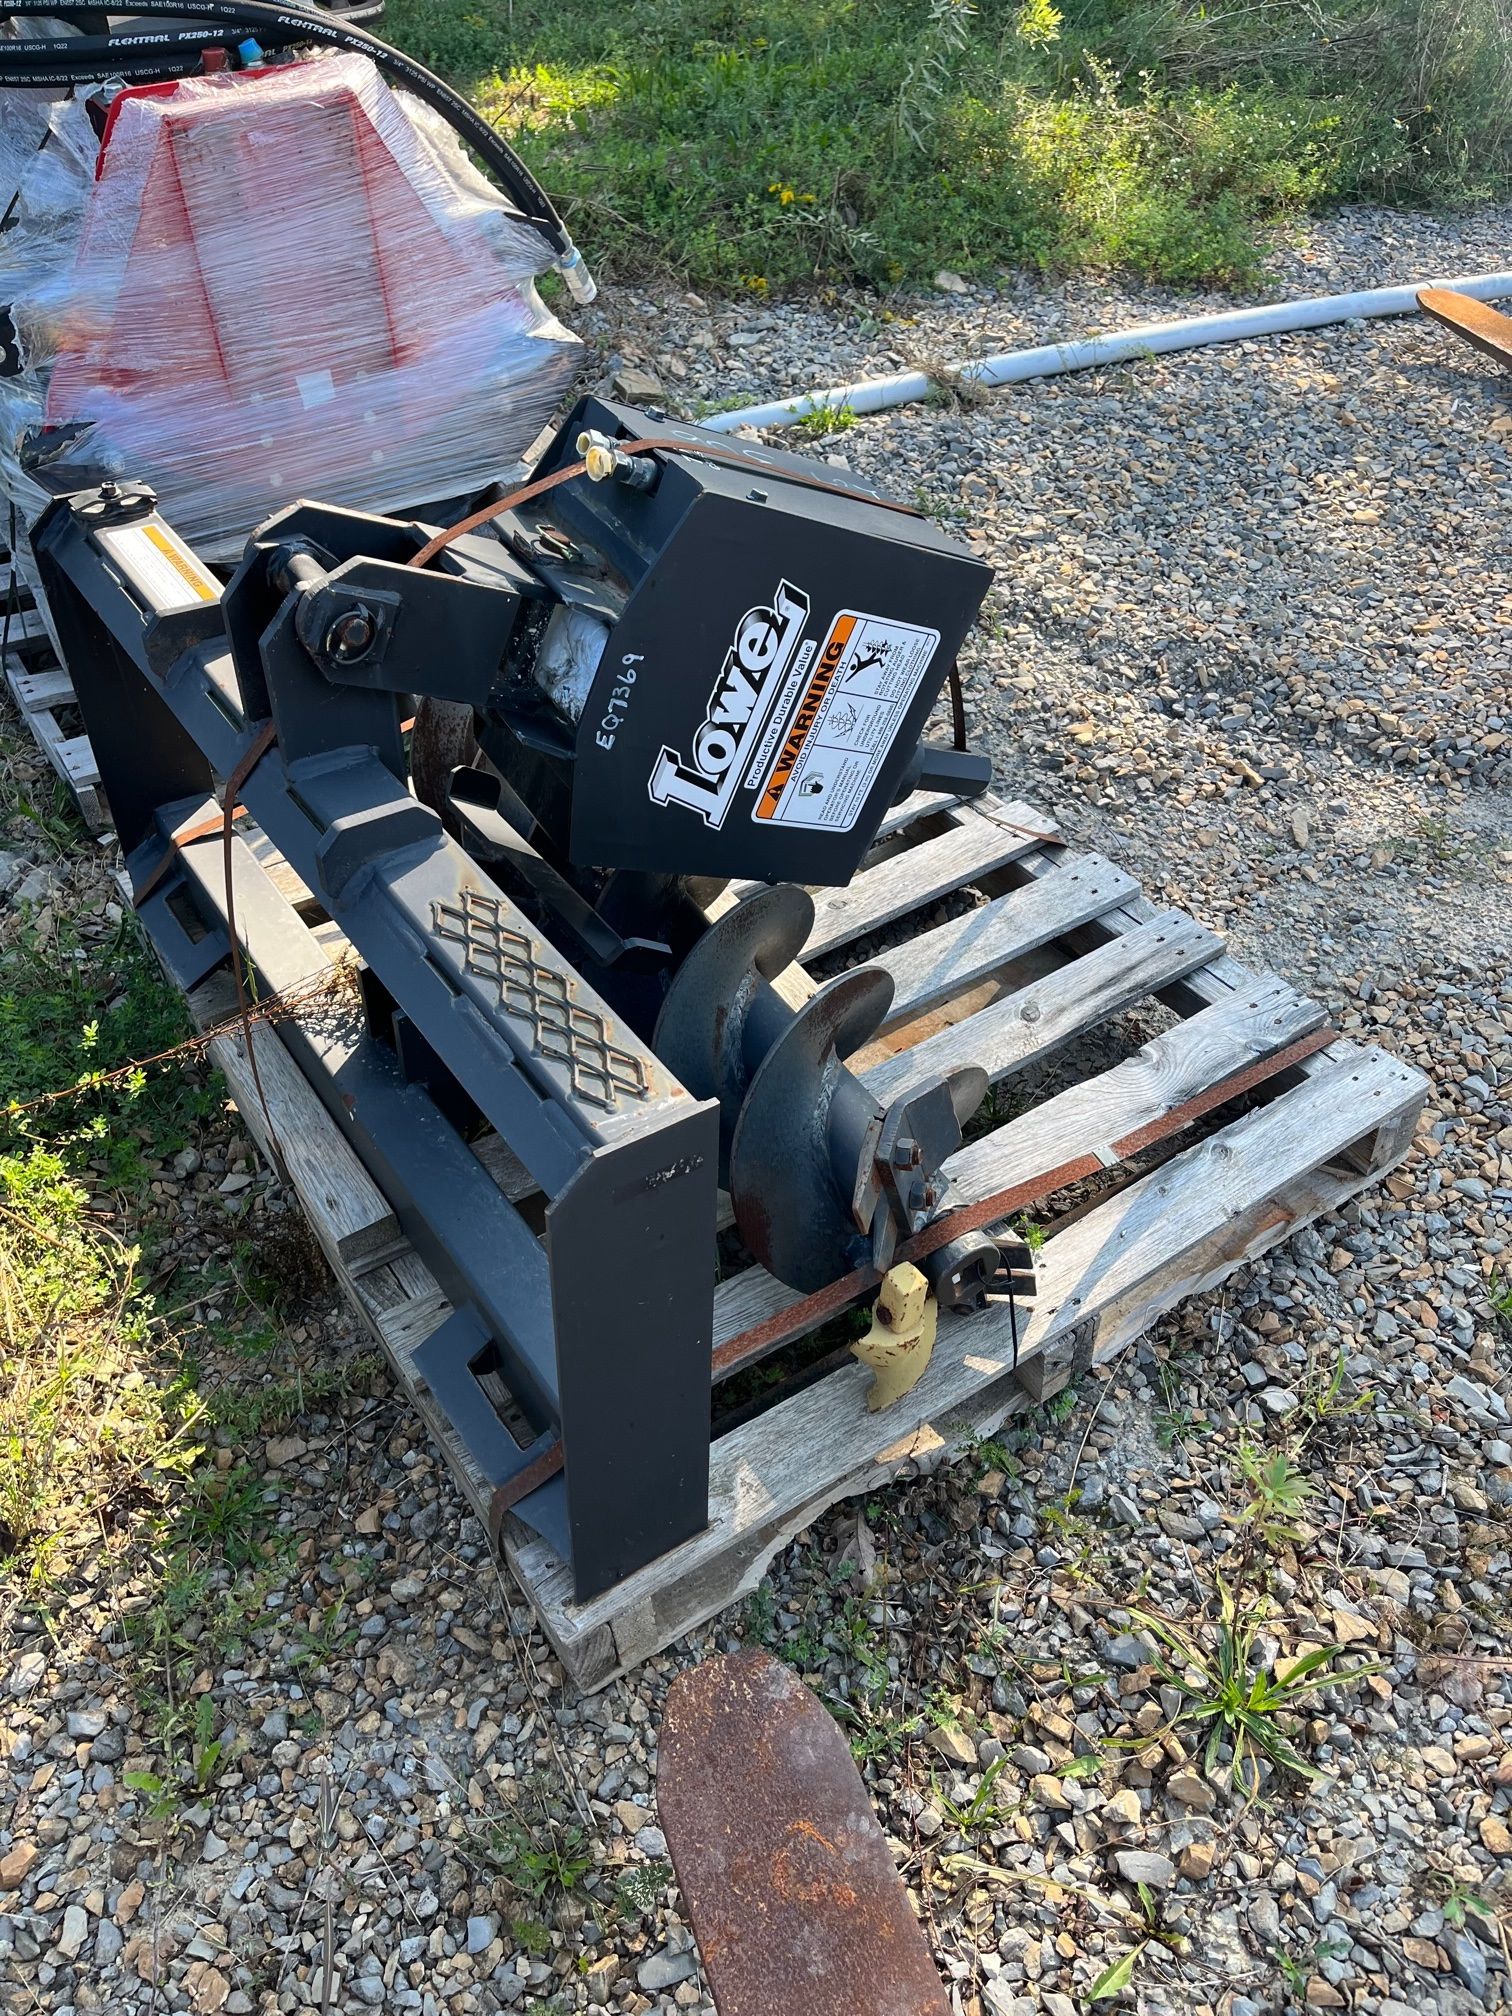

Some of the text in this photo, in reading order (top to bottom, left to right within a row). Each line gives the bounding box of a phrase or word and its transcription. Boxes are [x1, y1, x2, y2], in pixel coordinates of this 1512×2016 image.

[108, 35, 170, 46] FLEXTRAL
[178, 29, 224, 40] PX250-12
[278, 15, 338, 38] FLEXTRAL
[344, 36, 388, 59] PX250-12
[168, 553, 204, 588] WARNING
[874, 645, 899, 694] STAY AWAY FROM
[879, 667, 894, 695] ROTATING
[892, 646, 904, 666] AUGER
[884, 654, 905, 696] CUTTING HEAD
[890, 638, 919, 697] DO NOT WEAR LOOSE
[895, 646, 921, 698] FITTING CLOTHING
[596, 653, 644, 750] EQ7369
[776, 640, 844, 773] WARNING
[791, 661, 846, 781] AVOID INJURY OR DEATH
[872, 749, 882, 764] MORE
[880, 733, 889, 748] AWAY
[887, 710, 900, 732] UNLESS
[897, 677, 915, 709] OPERATING
[913, 649, 927, 676] MACHINE
[747, 726, 778, 786] Productive
[773, 679, 798, 724] Durable
[854, 727, 865, 745] CHECK
[860, 704, 881, 746] UNDERGROUND
[865, 710, 884, 747] UTILITY LINES
[830, 757, 848, 792] UNDERSTAND
[835, 769, 861, 821] SERVICING MACHINE
[838, 765, 851, 787] MANUAL
[839, 769, 855, 799] OPERATING
[852, 760, 859, 769] OR
